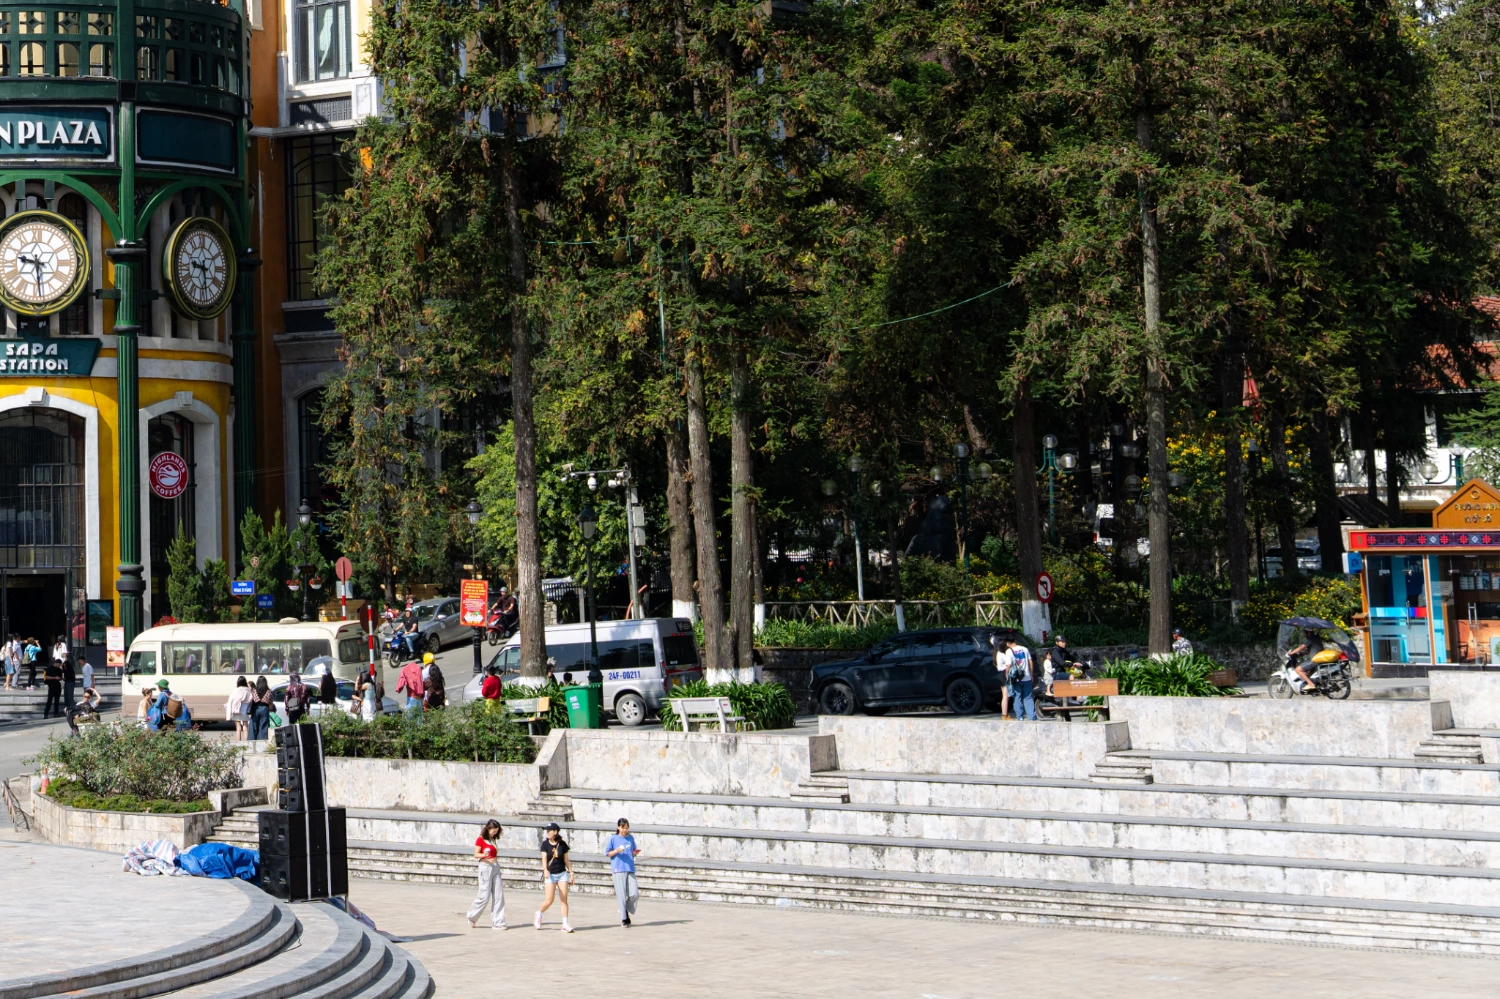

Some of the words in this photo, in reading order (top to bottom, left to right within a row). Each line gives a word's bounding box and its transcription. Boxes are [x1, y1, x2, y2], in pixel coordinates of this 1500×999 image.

[18, 120, 102, 145] PLAZA
[6, 343, 58, 356] SAPA
[0, 358, 69, 371] STATION
[151, 454, 186, 474] HIGHLANDS
[155, 484, 182, 496] COFFEE
[608, 670, 641, 681] 24F-00211
